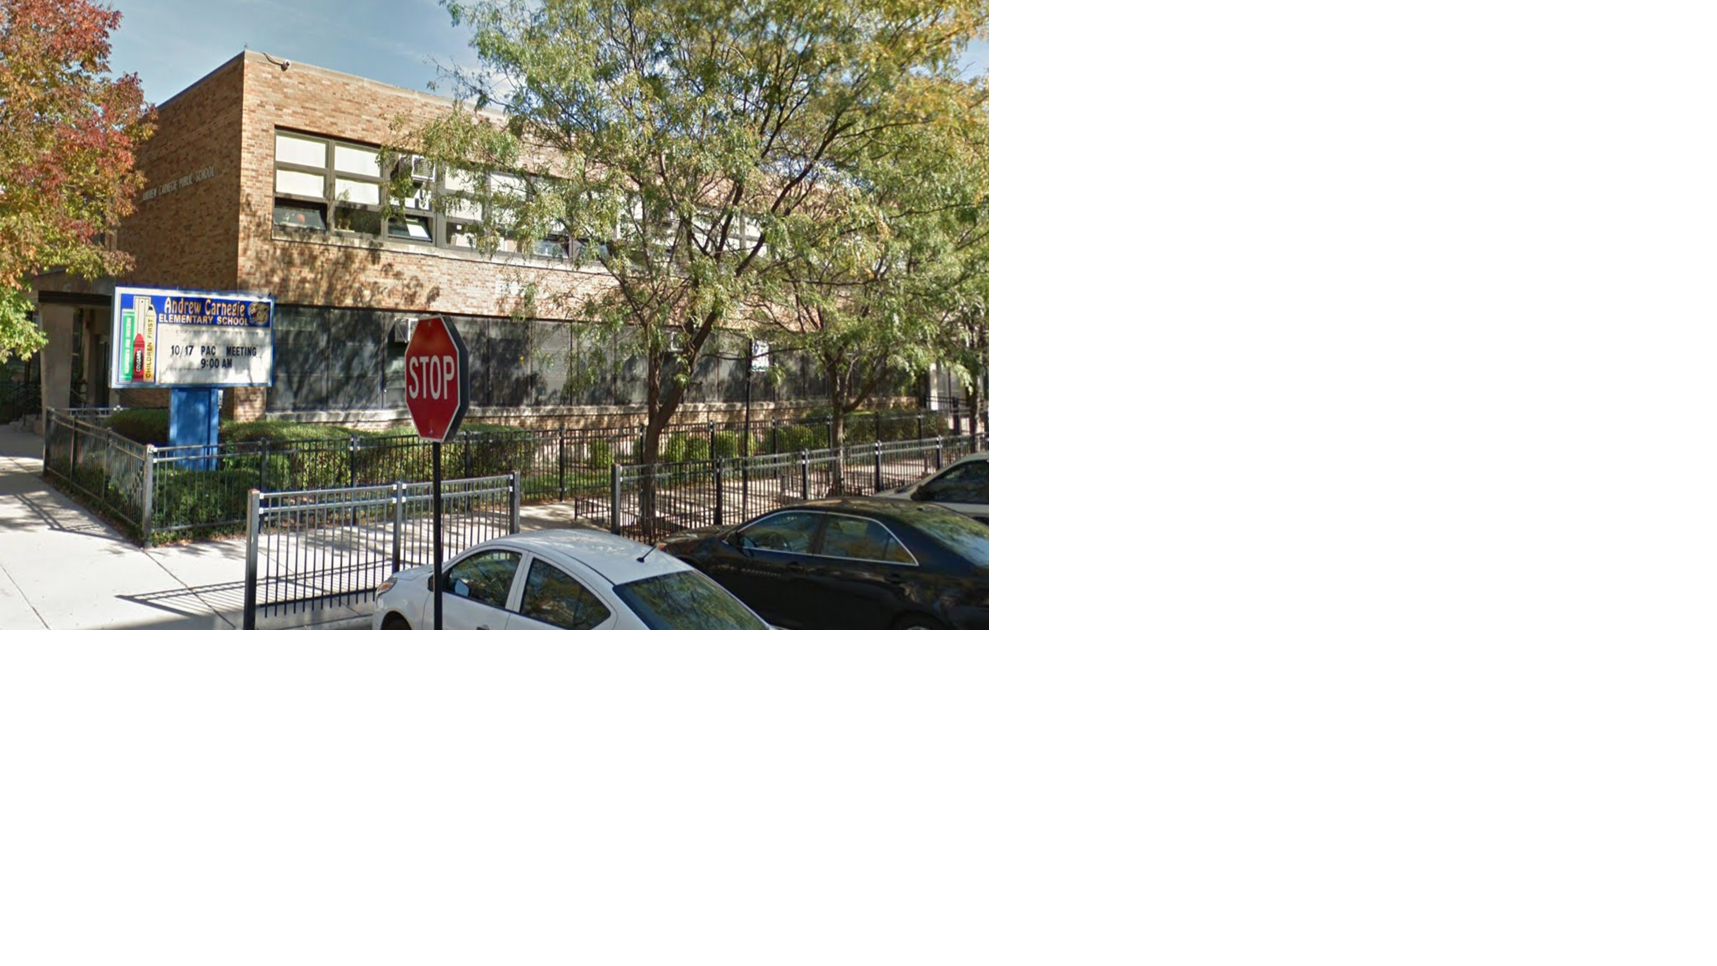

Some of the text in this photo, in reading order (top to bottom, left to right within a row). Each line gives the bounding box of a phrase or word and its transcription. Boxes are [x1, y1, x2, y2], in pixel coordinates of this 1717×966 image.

[196, 166, 215, 182] SCHOOL
[164, 296, 245, 317] Andrew Carnegie
[158, 313, 249, 326] ELEMENTARY SCHOOL
[171, 345, 257, 357] 10/17 PAC MEETING
[145, 342, 153, 379] CHILDREN
[200, 358, 233, 369] 9:00 AM
[408, 355, 455, 400] STOP
